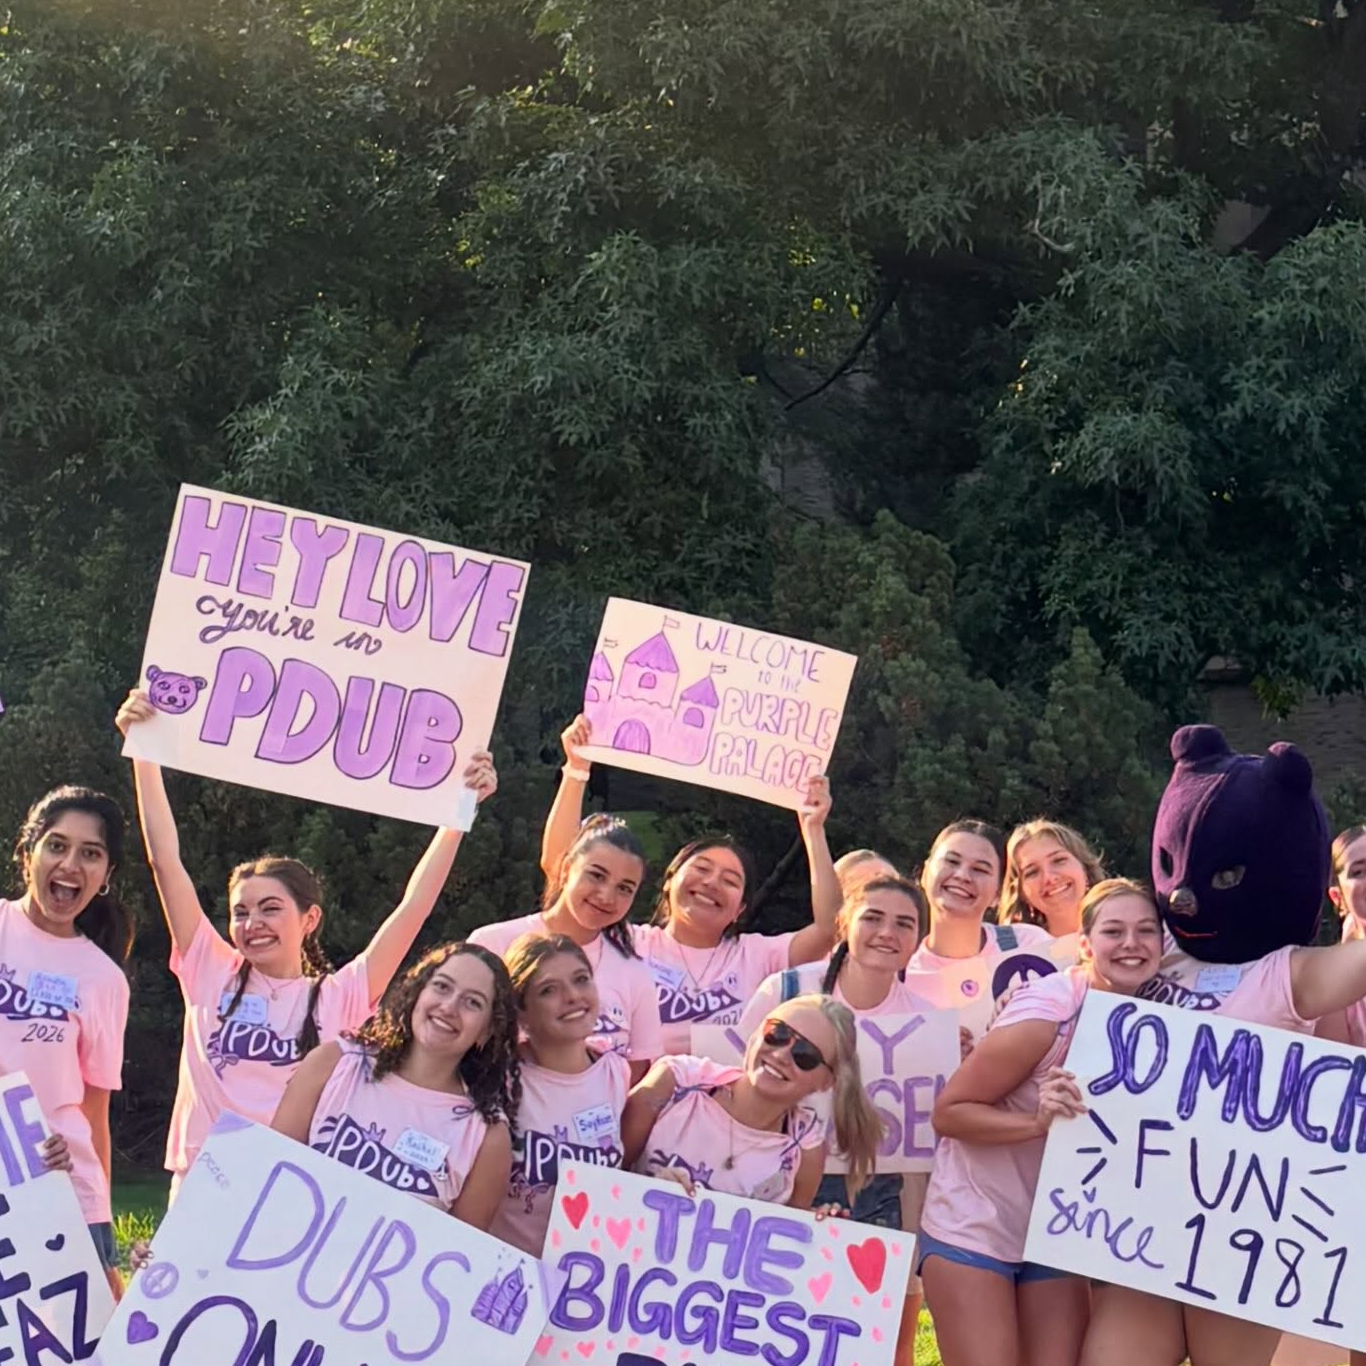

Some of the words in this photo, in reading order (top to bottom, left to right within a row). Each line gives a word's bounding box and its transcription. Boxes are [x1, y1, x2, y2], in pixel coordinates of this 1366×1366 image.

[170, 495, 350, 609] HEY
[339, 532, 526, 657] LOVE
[333, 631, 382, 655] in
[695, 622, 826, 683] WELCOME
[199, 646, 463, 789] PDUB
[721, 686, 838, 751] PURPLE
[1087, 1001, 1169, 1096] SO
[1135, 1119, 1289, 1222] FUN
[226, 1160, 471, 1362] DUBS
[642, 1188, 814, 1296] THE
[1175, 1213, 1348, 1328] 1981
